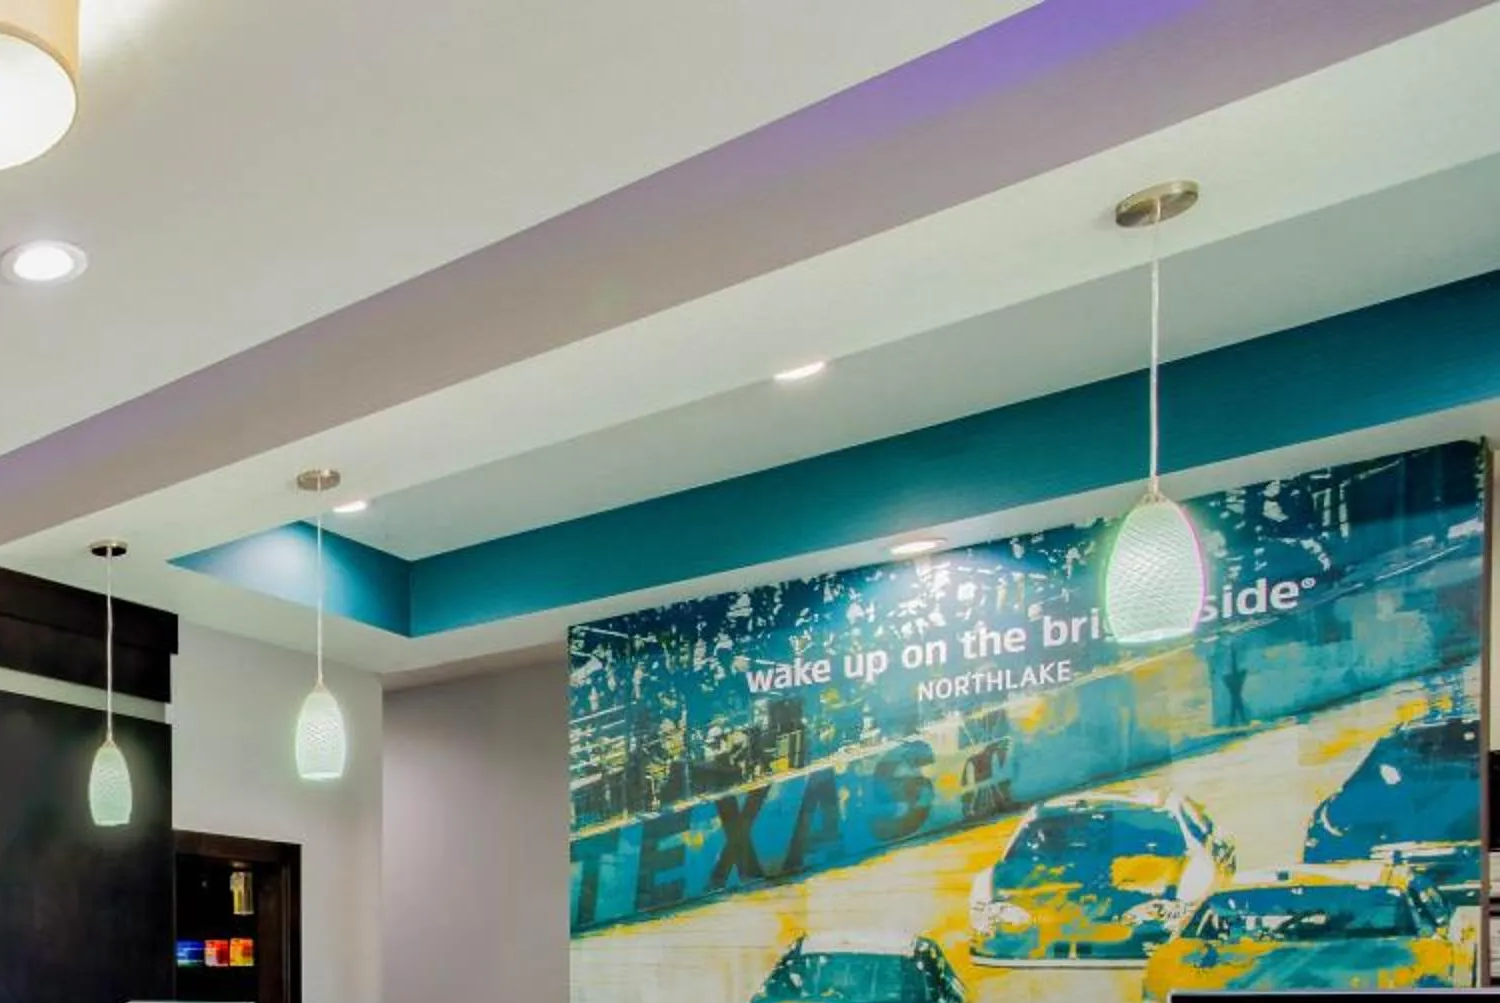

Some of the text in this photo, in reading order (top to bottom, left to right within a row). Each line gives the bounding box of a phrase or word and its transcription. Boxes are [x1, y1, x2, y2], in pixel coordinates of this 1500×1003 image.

[747, 655, 831, 693] wake
[844, 648, 887, 683] up
[901, 639, 947, 669] on
[960, 620, 1026, 659] the
[917, 659, 1071, 701] NORTHLAKE
[570, 739, 936, 926] TEXAS
